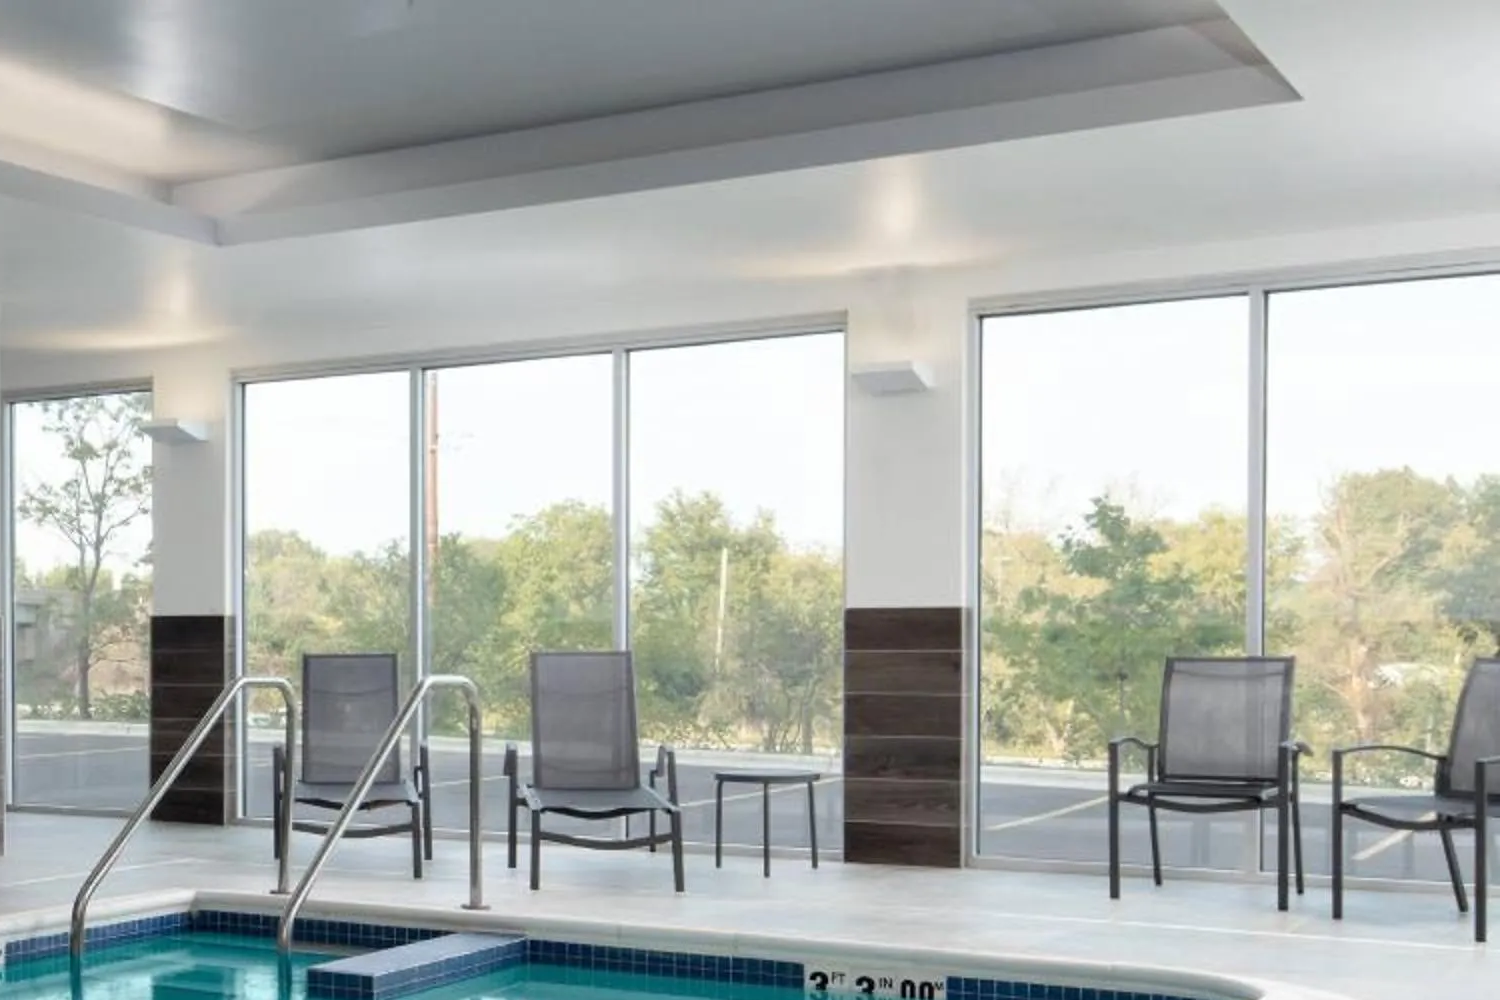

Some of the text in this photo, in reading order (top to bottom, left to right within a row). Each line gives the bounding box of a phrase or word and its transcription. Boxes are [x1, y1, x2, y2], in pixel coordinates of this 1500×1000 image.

[810, 971, 829, 993] 3
[831, 971, 846, 985] FT
[855, 976, 875, 997] 3
[879, 977, 893, 989] IN
